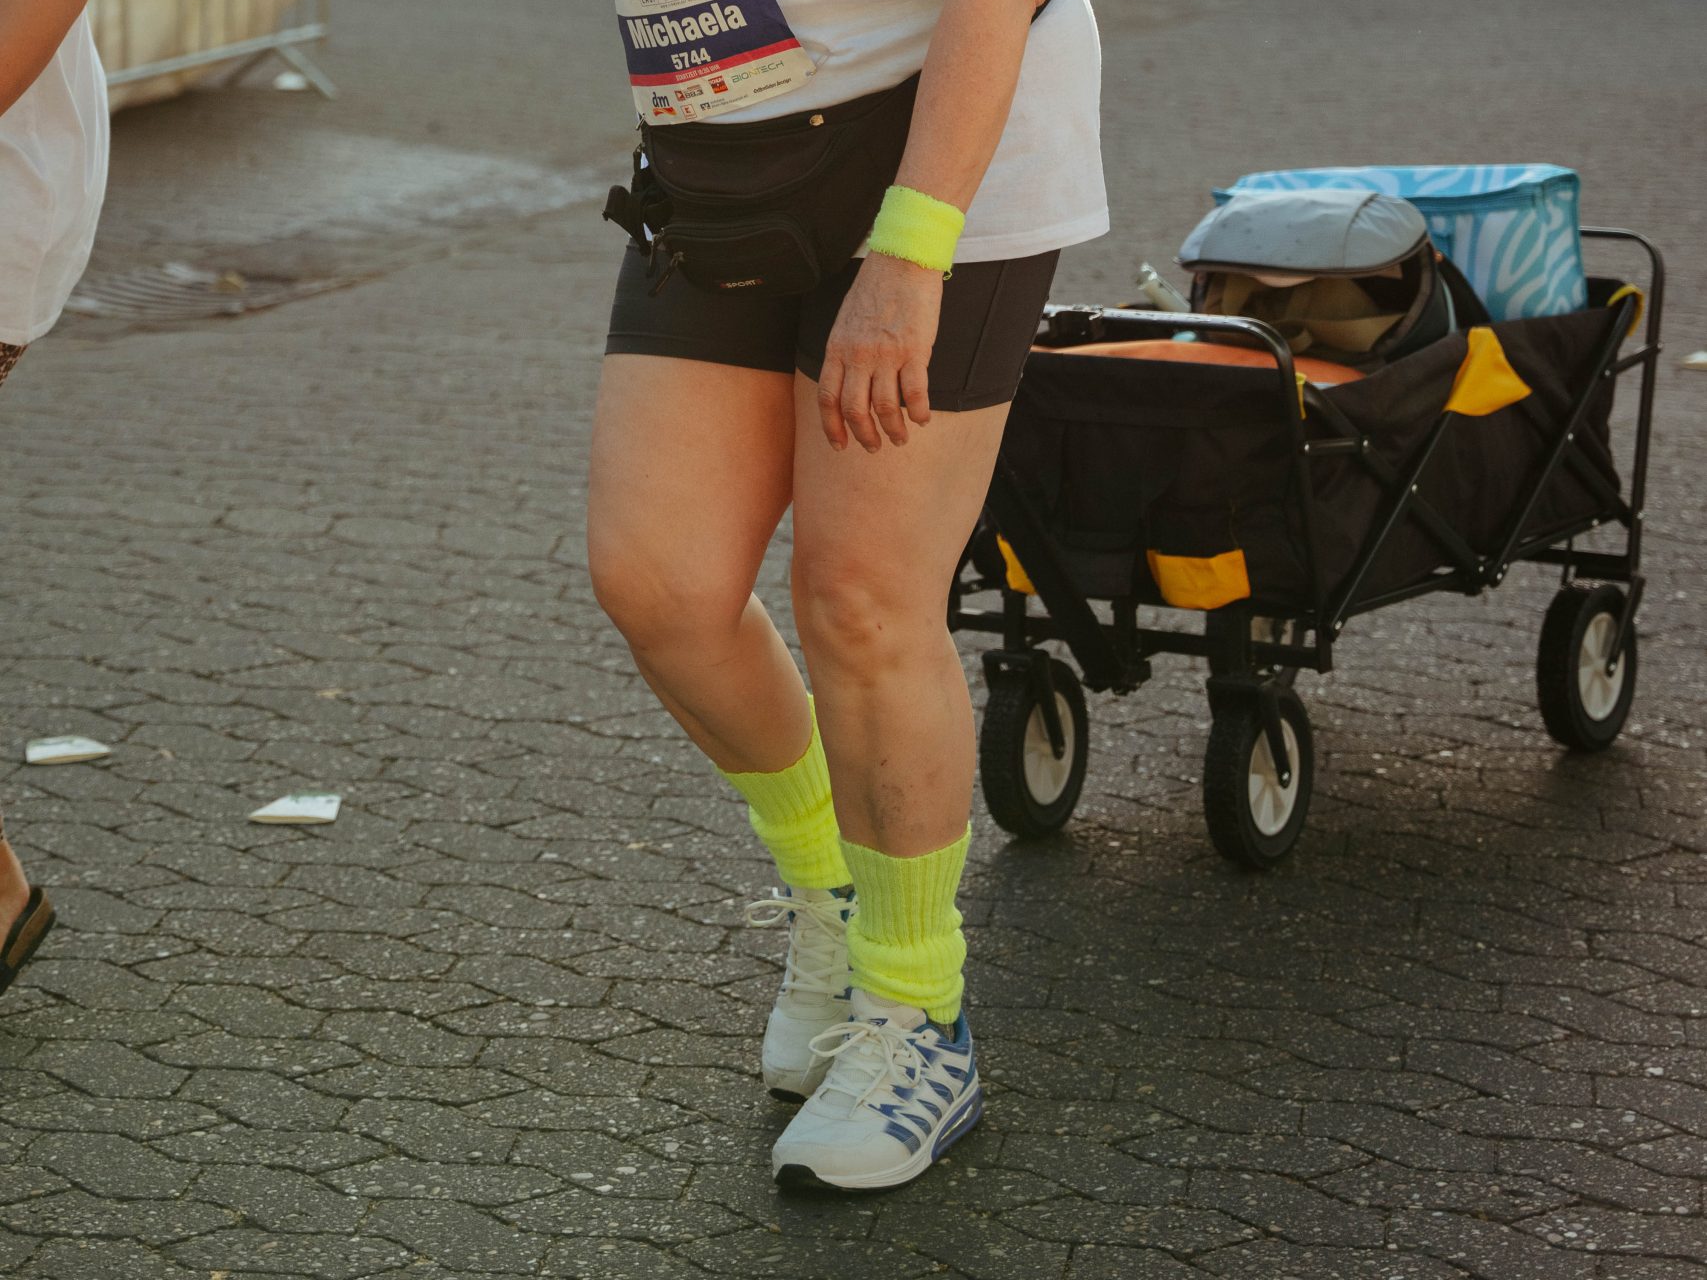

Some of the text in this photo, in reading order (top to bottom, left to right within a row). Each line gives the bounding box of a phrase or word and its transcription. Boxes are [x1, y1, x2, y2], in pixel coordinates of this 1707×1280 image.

[627, 3, 747, 49] Michaela
[671, 48, 711, 70] 5744
[731, 60, 785, 83] BIONTECH
[652, 91, 670, 108] dm
[726, 280, 756, 288] SPORT
